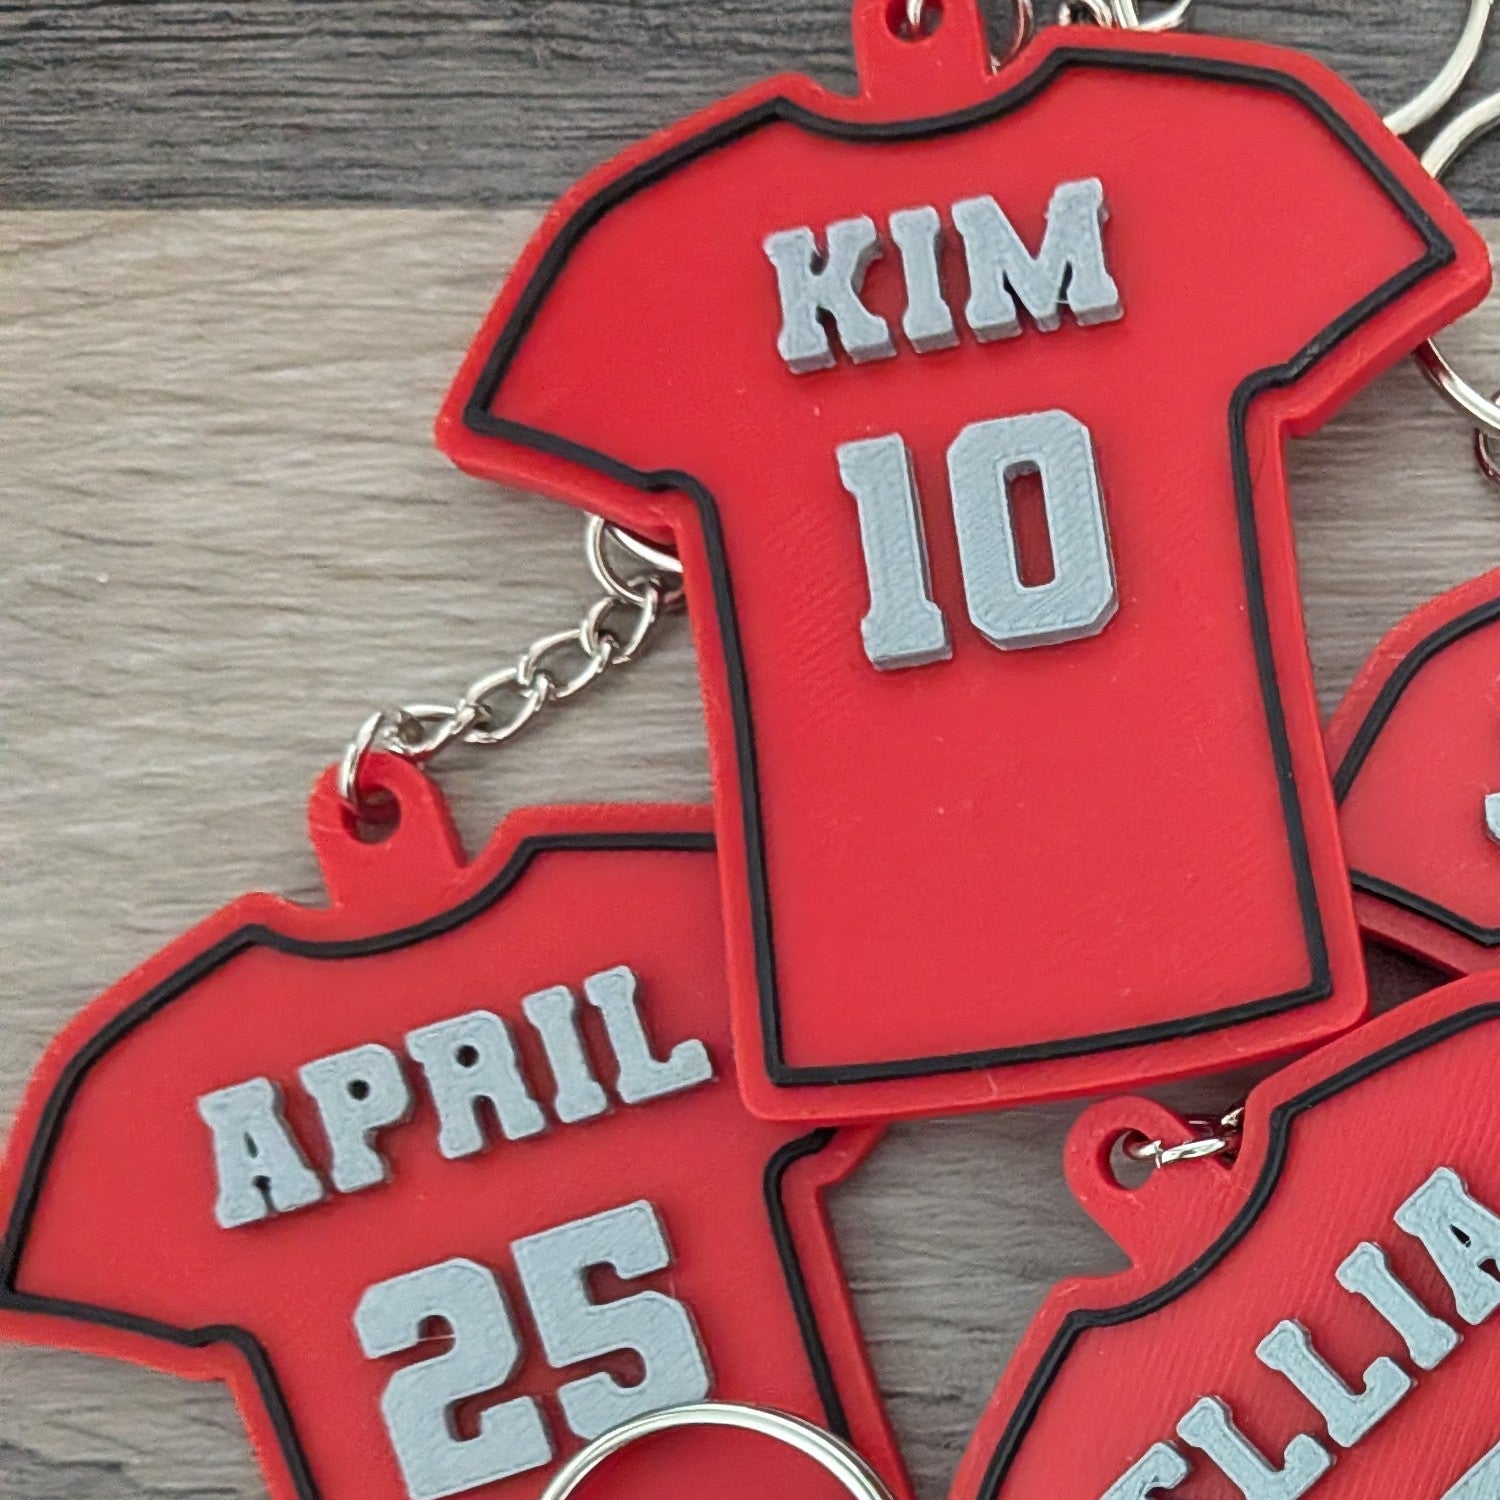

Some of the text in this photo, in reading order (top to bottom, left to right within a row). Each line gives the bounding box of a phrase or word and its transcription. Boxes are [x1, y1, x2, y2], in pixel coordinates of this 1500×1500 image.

[763, 176, 1124, 375] KIM
[835, 408, 1119, 672] 10
[197, 964, 715, 1230] APRIL
